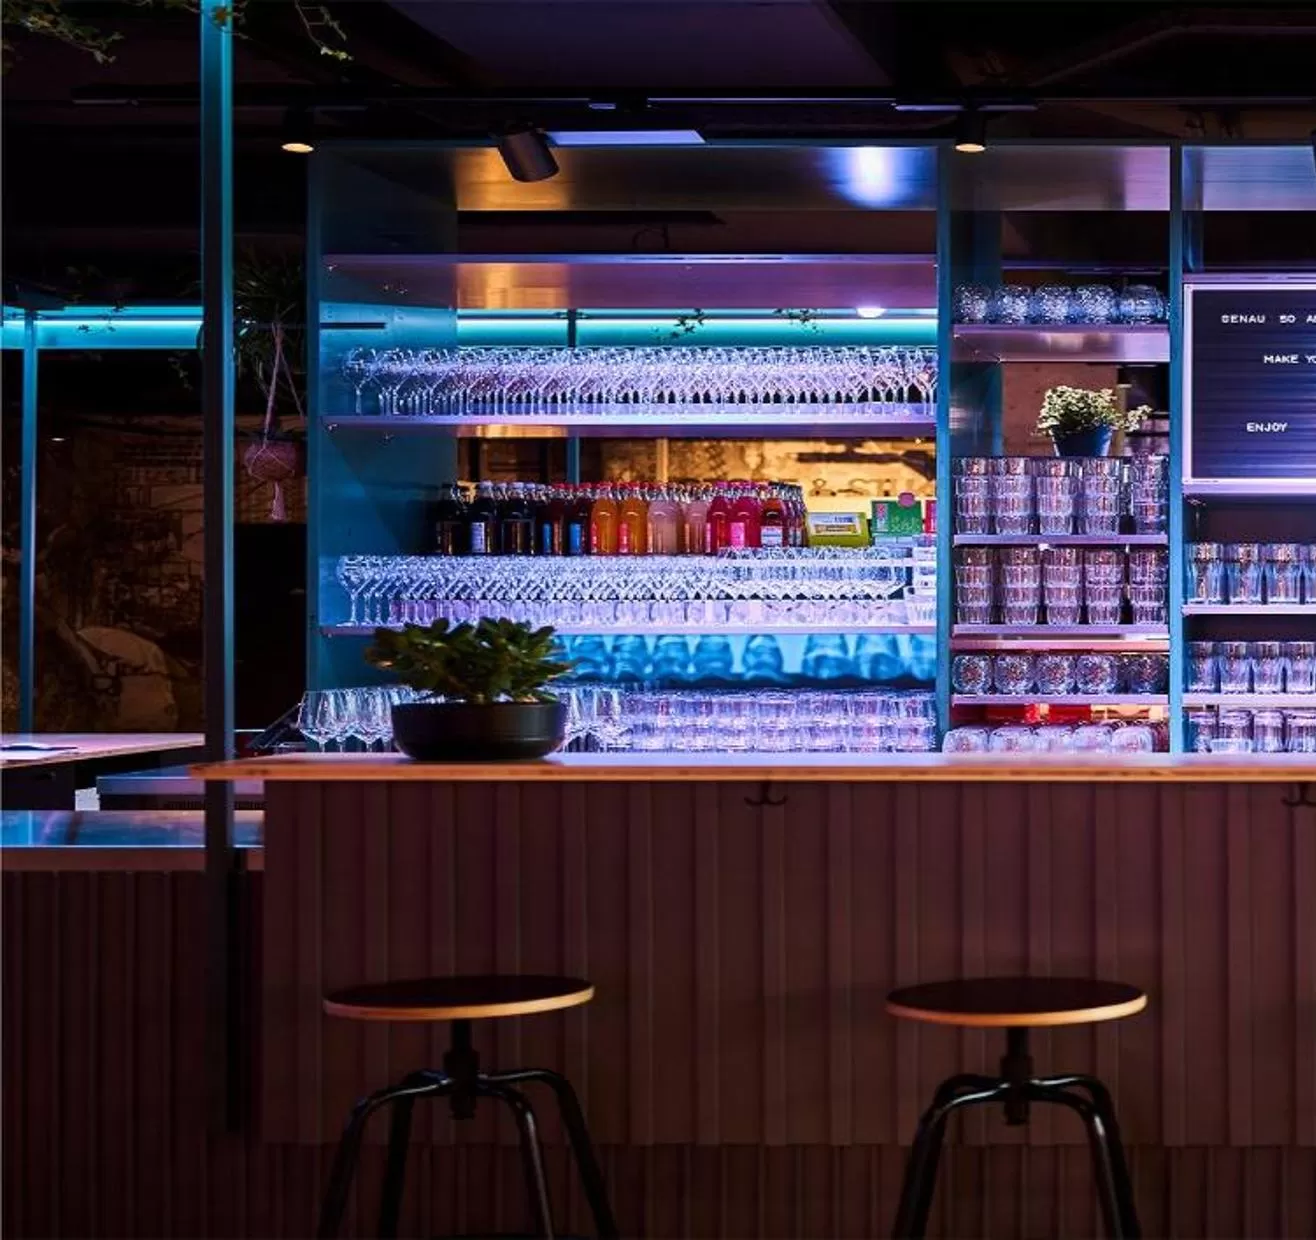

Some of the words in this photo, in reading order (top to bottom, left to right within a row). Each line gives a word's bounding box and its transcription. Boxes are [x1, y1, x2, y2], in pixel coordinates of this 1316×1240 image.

[1279, 314, 1297, 324] SO
[1263, 354, 1299, 364] MAKE
[1246, 422, 1288, 433] ENJOY
